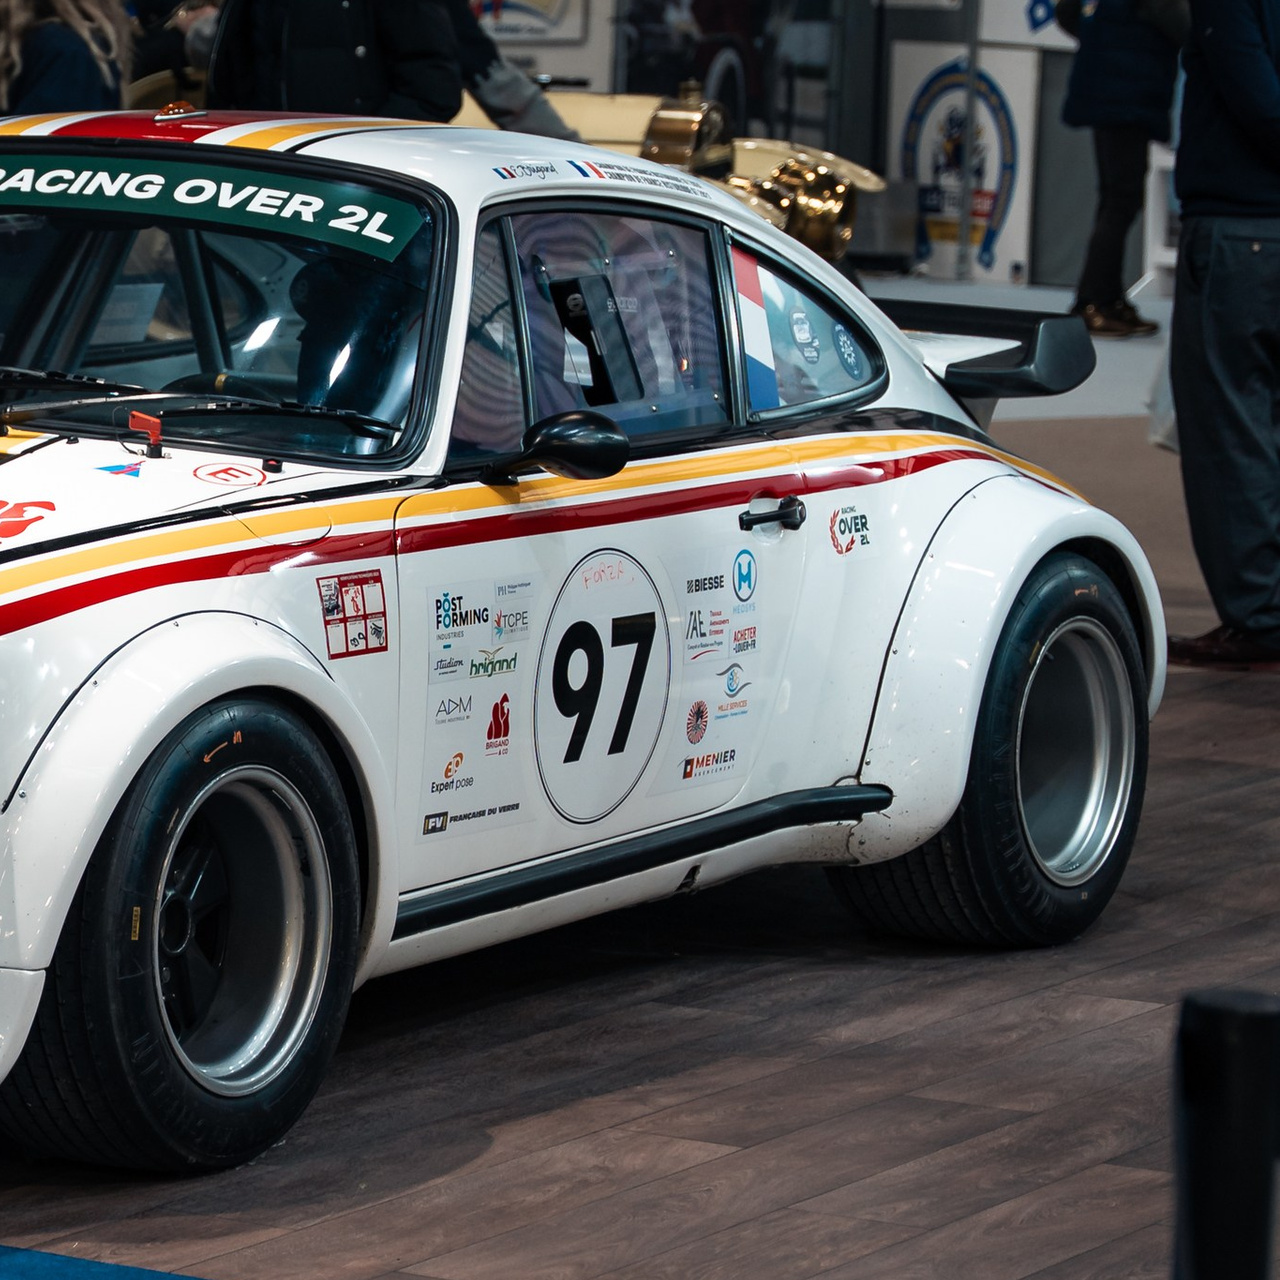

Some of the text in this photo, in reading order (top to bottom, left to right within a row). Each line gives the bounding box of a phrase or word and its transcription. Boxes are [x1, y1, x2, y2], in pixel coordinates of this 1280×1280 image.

[173, 178, 324, 225] OVER
[327, 205, 396, 245] 2L
[838, 514, 869, 535] OVER
[694, 575, 725, 592] BIESSE
[436, 607, 489, 630] FORMING
[502, 611, 528, 628] TCPE
[733, 626, 757, 643] ACHETER
[469, 652, 517, 677] brigand
[552, 611, 657, 764] 97
[485, 740, 509, 750] BRIGAND
[696, 749, 736, 769] MENIER
[431, 776, 474, 794] Expert pose
[487, 806, 497, 816] DU
[498, 802, 520, 814] VERRE
